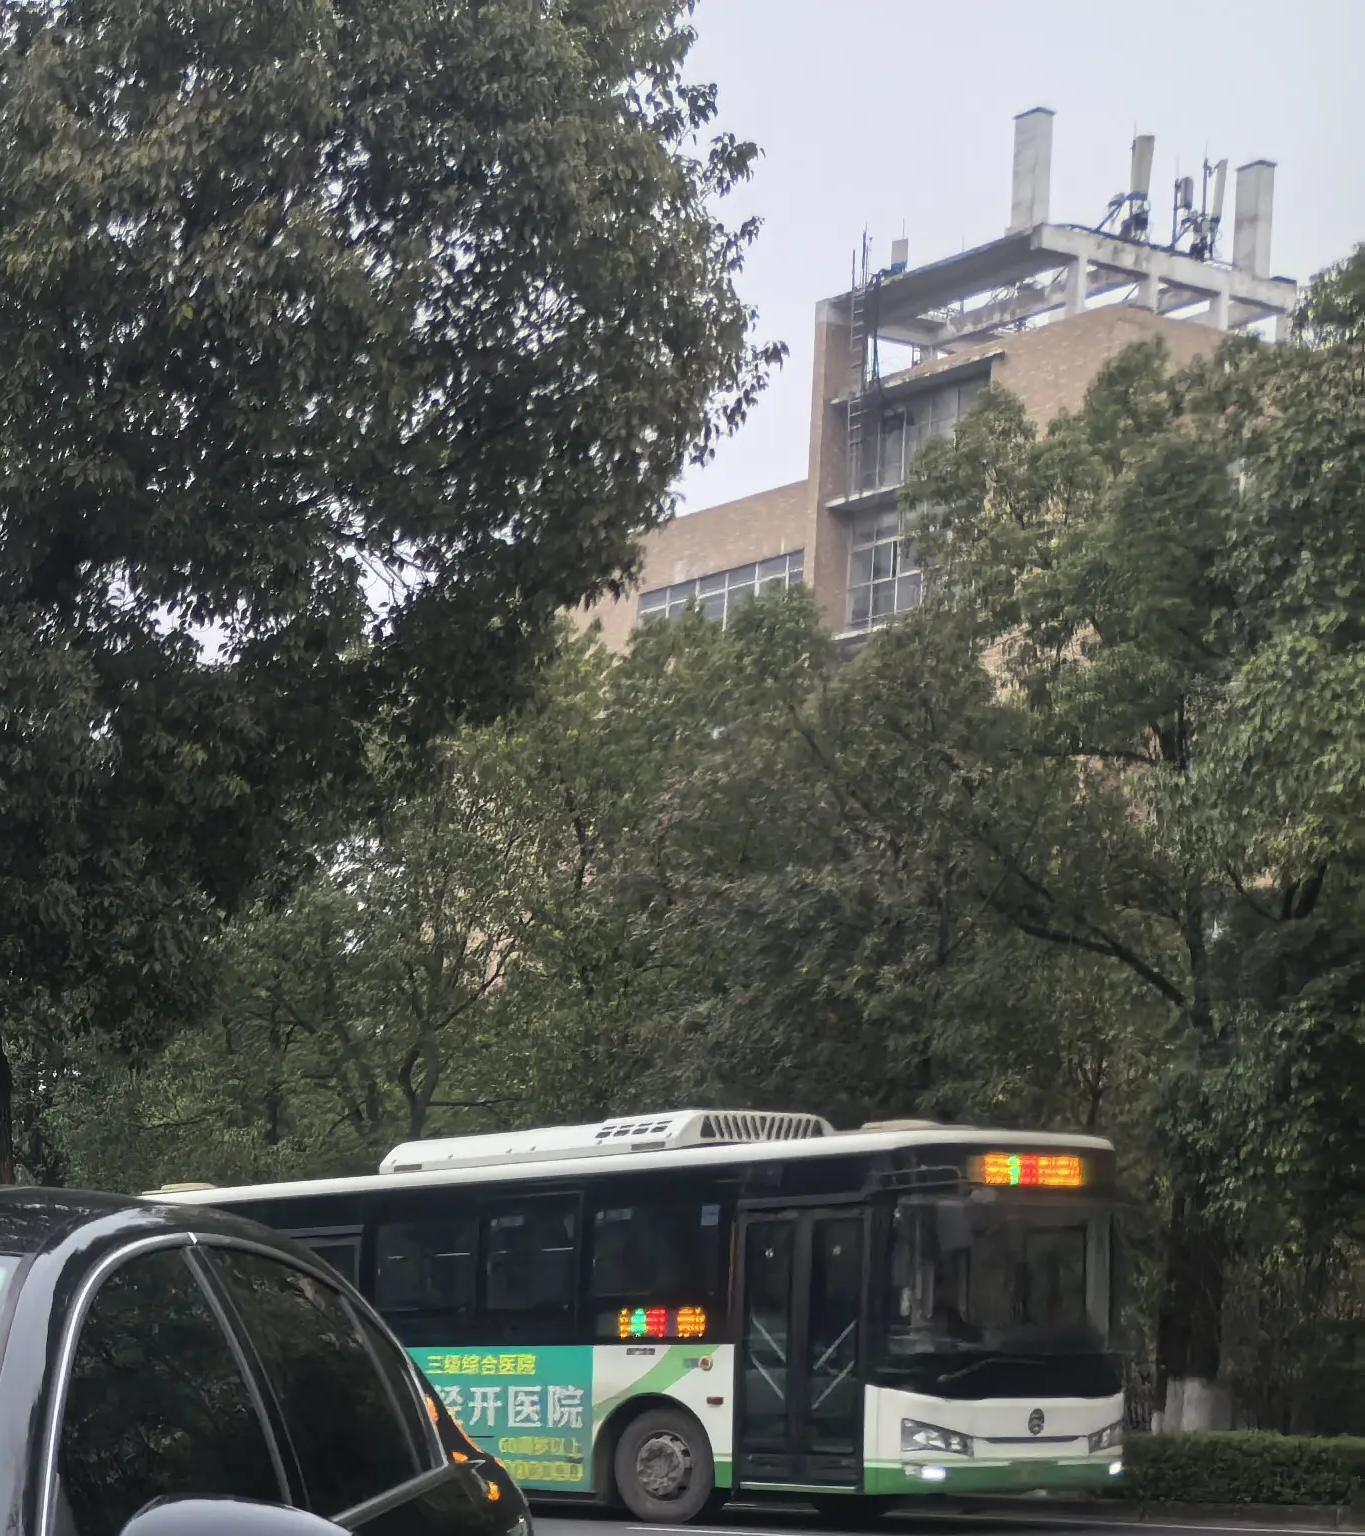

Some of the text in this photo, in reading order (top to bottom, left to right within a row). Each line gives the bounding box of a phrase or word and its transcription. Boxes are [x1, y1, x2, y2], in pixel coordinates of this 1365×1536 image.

[427, 1354, 537, 1375] 三级综合医院
